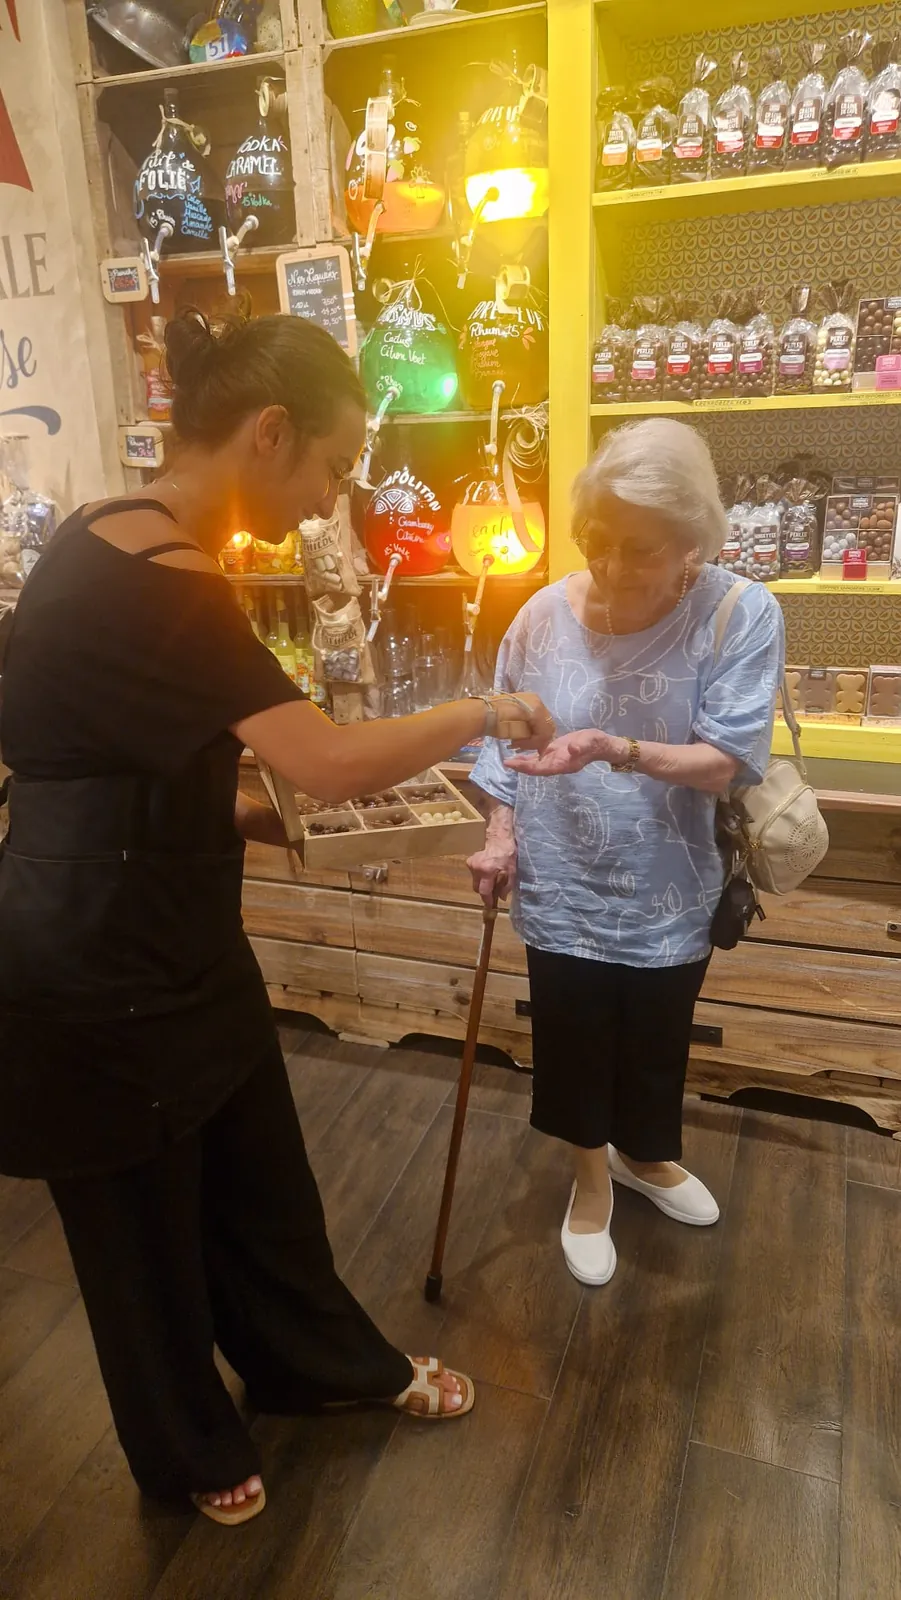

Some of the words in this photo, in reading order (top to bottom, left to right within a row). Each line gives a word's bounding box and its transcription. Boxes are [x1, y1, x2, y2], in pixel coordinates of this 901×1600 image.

[209, 34, 227, 57] 51
[139, 168, 187, 191] FOLIE
[0, 232, 55, 299] LE
[384, 331, 412, 348] Cactus
[469, 322, 501, 338] Rhum
[380, 345, 407, 361] Citron
